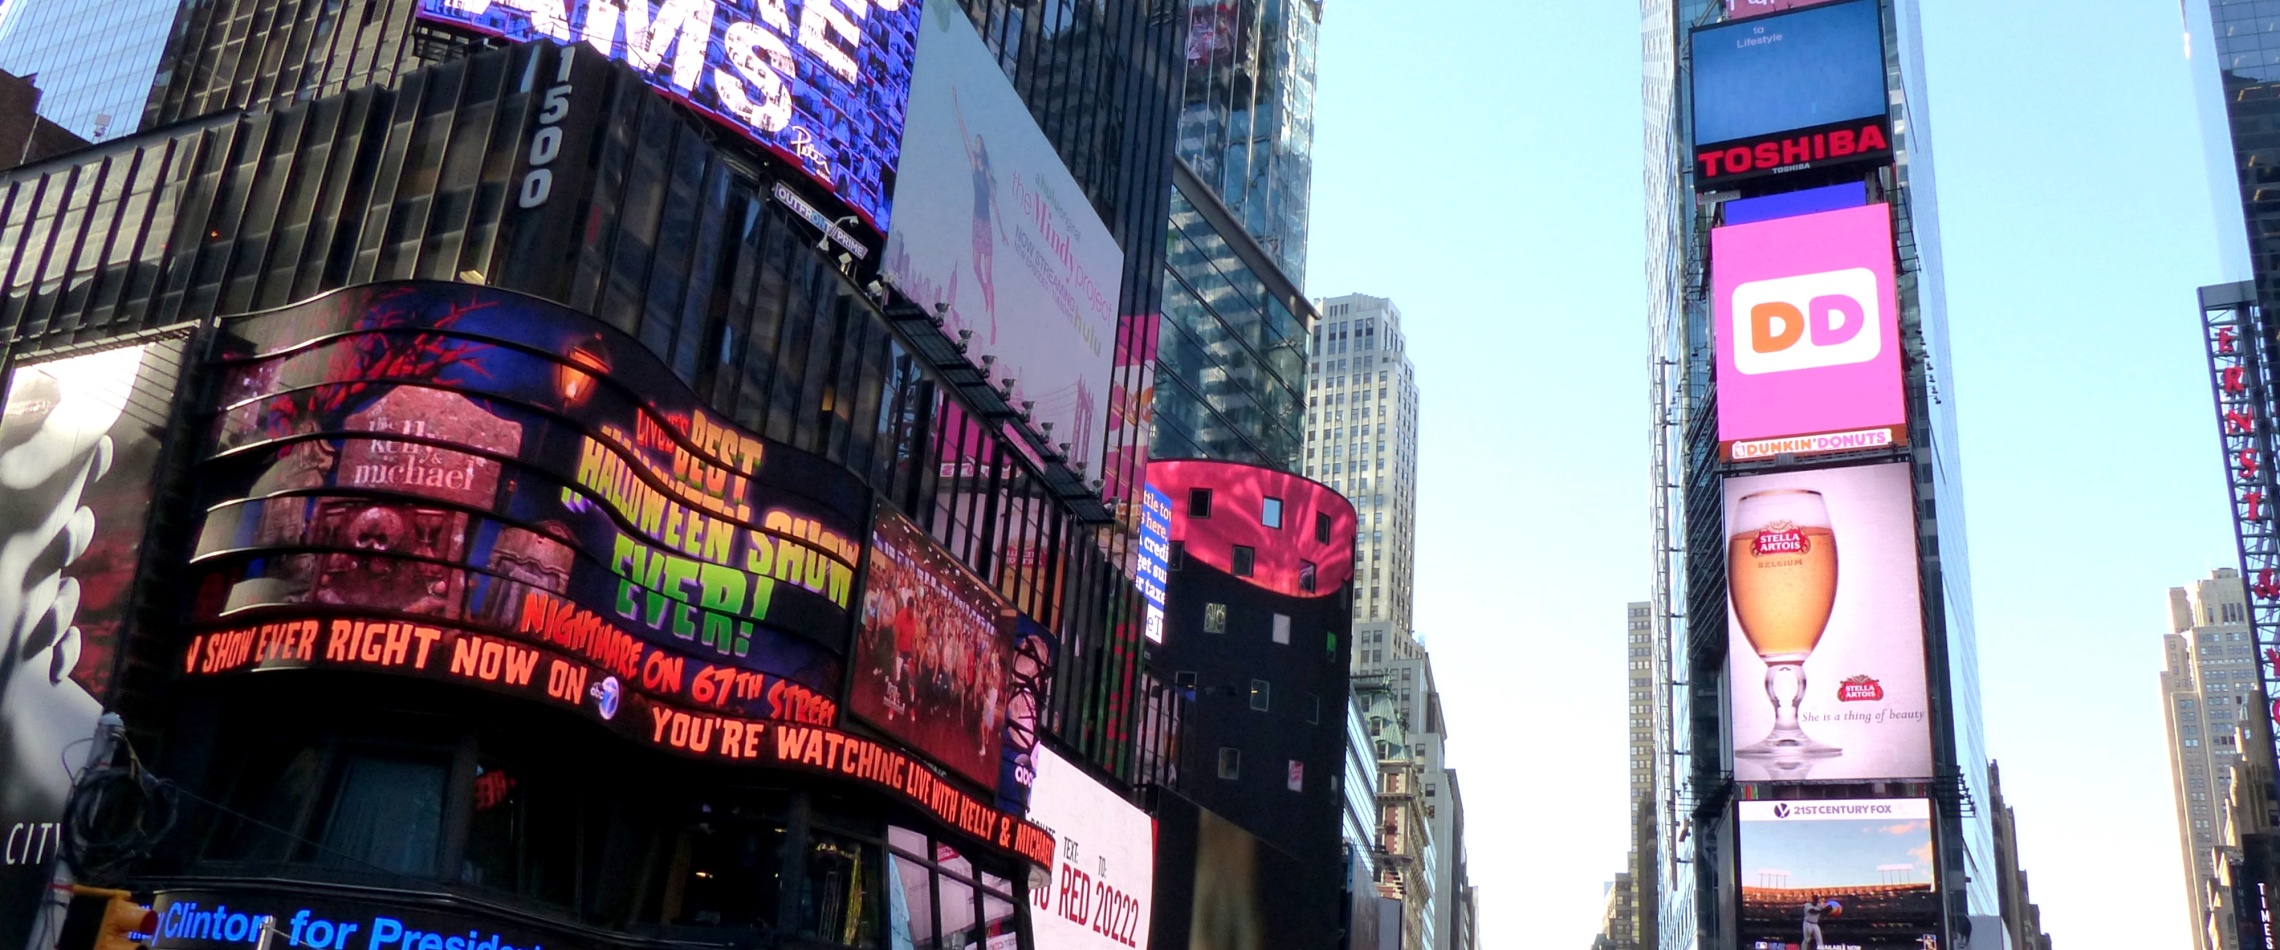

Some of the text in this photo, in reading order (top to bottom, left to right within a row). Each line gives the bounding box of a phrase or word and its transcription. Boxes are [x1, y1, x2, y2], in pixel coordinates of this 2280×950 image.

[1737, 33, 1783, 48] Lifestyle
[519, 46, 576, 209] 1500
[1697, 124, 1888, 177] TOSHIBA
[1772, 162, 1811, 175] TOSHIBA
[836, 230, 864, 255] PRIME
[1012, 170, 1113, 328] the Mindy project
[1016, 223, 1035, 257] NOW
[1074, 304, 1102, 358] hulu
[1751, 294, 1865, 354] DD
[2216, 326, 2263, 522] ERNST
[353, 455, 476, 491] michael
[673, 409, 764, 504] BEST
[746, 511, 860, 609] SHOW
[1757, 559, 1803, 568] BELGIUM
[1760, 533, 1800, 544] STELLA
[1760, 541, 1801, 552] ARTOIS
[611, 533, 775, 658] EVER!
[202, 626, 256, 673] SHOW
[255, 620, 319, 662] EVER
[326, 620, 442, 669] RIGHT
[450, 637, 540, 687] NOW
[547, 658, 588, 704] ON
[521, 593, 644, 680] NIGHTMARE
[643, 650, 684, 693] ON
[767, 679, 837, 728] STREET
[1802, 711, 1820, 722] She
[1823, 712, 1832, 721] is
[1844, 709, 1872, 724] thing
[1875, 708, 1888, 724] of
[1889, 708, 1926, 723] beauty
[1845, 691, 1876, 699] ARTOIS
[653, 706, 765, 758] YOU'RE
[776, 726, 906, 790] WATCHING
[906, 761, 931, 806] LIVE
[931, 778, 960, 825] WITH
[960, 795, 997, 845] KELLY
[999, 815, 1011, 849] &
[1794, 804, 1892, 815] 21ST CENTURY FOX
[289, 910, 358, 950] for
[1058, 862, 1091, 926] RED
[1093, 881, 1140, 949] 20222
